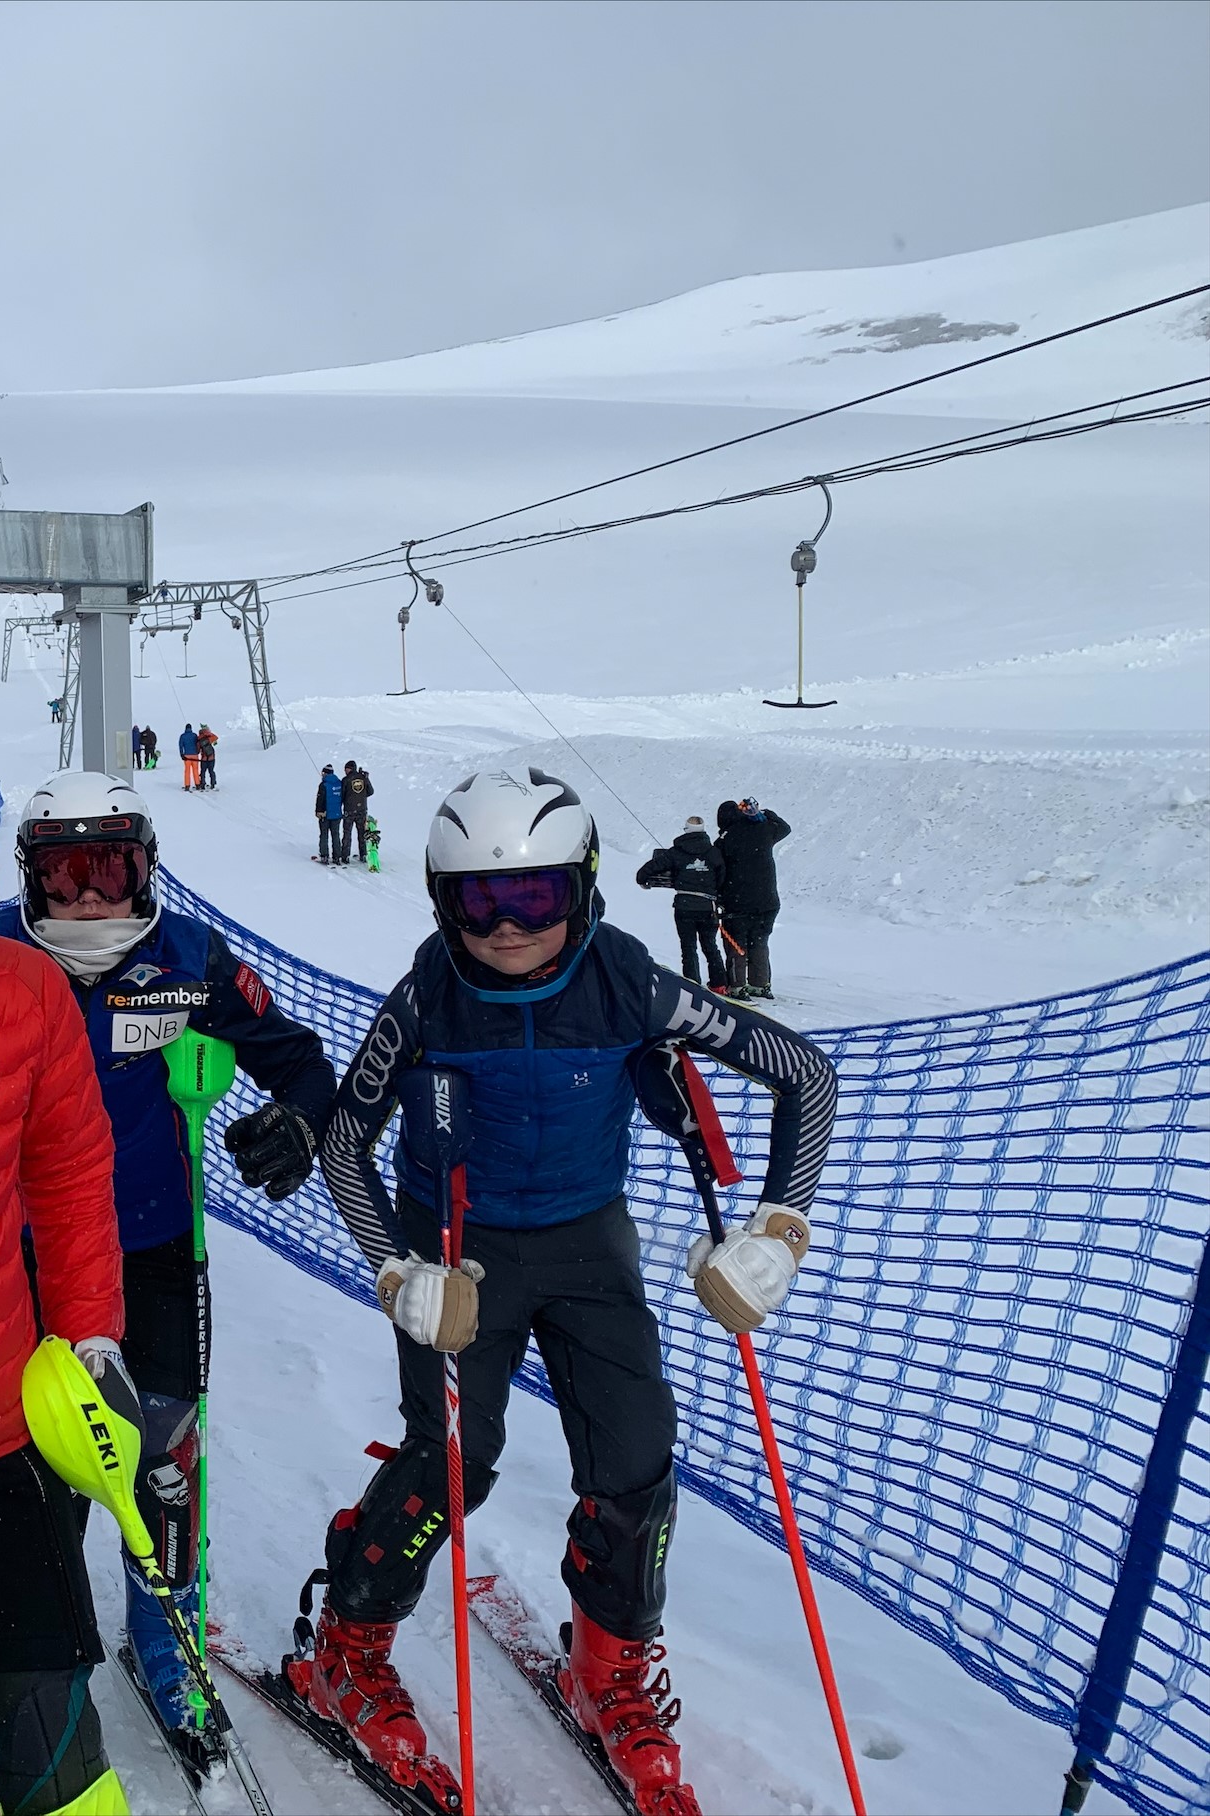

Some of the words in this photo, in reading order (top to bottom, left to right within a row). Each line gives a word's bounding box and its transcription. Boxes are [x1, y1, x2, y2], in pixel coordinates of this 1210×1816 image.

[106, 987, 211, 1007] re:member
[124, 1017, 178, 1049] DNB
[196, 1043, 206, 1092] KOMPERDELL
[433, 1074, 452, 1134] SWIX
[196, 1274, 206, 1387] KOMPERDELL
[80, 1402, 120, 1471] LEKI
[166, 1521, 178, 1579] ENERGIAPURA
[403, 1511, 444, 1559] LEKI
[655, 1523, 669, 1569] LEKI
